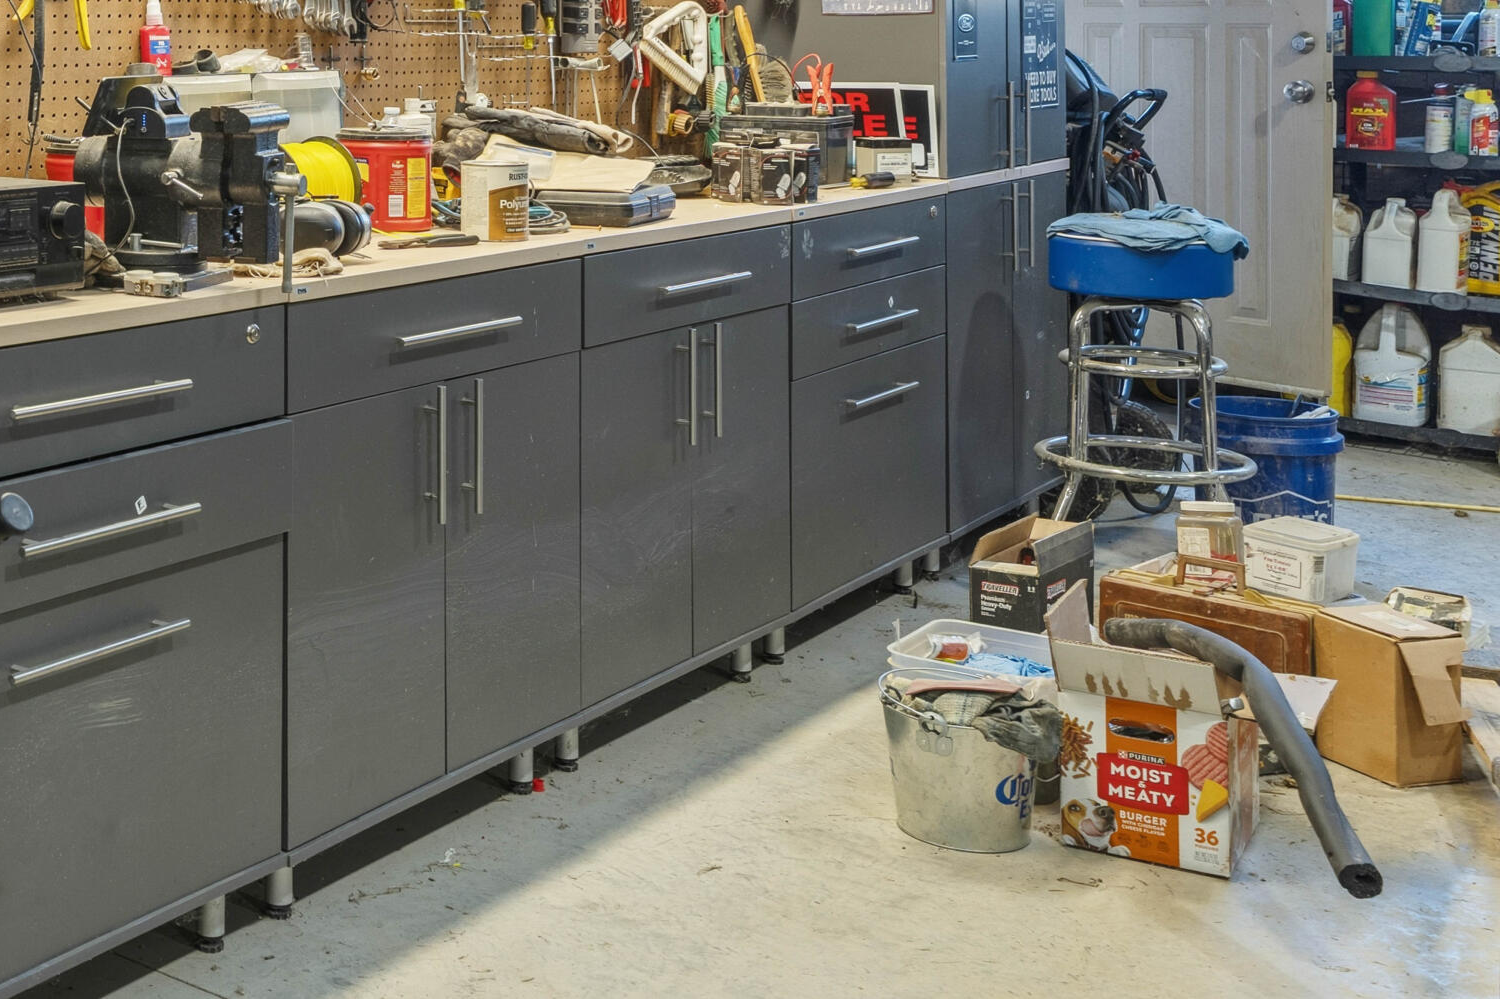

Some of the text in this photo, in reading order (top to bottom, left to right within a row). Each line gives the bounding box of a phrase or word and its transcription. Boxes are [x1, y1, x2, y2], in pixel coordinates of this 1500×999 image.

[1127, 752, 1165, 764] PURINA
[1110, 762, 1173, 786] MOIST
[1137, 780, 1147, 789] &
[1108, 783, 1176, 808] MEATY
[1119, 809, 1168, 828] BURGER
[1194, 827, 1219, 846] 36
